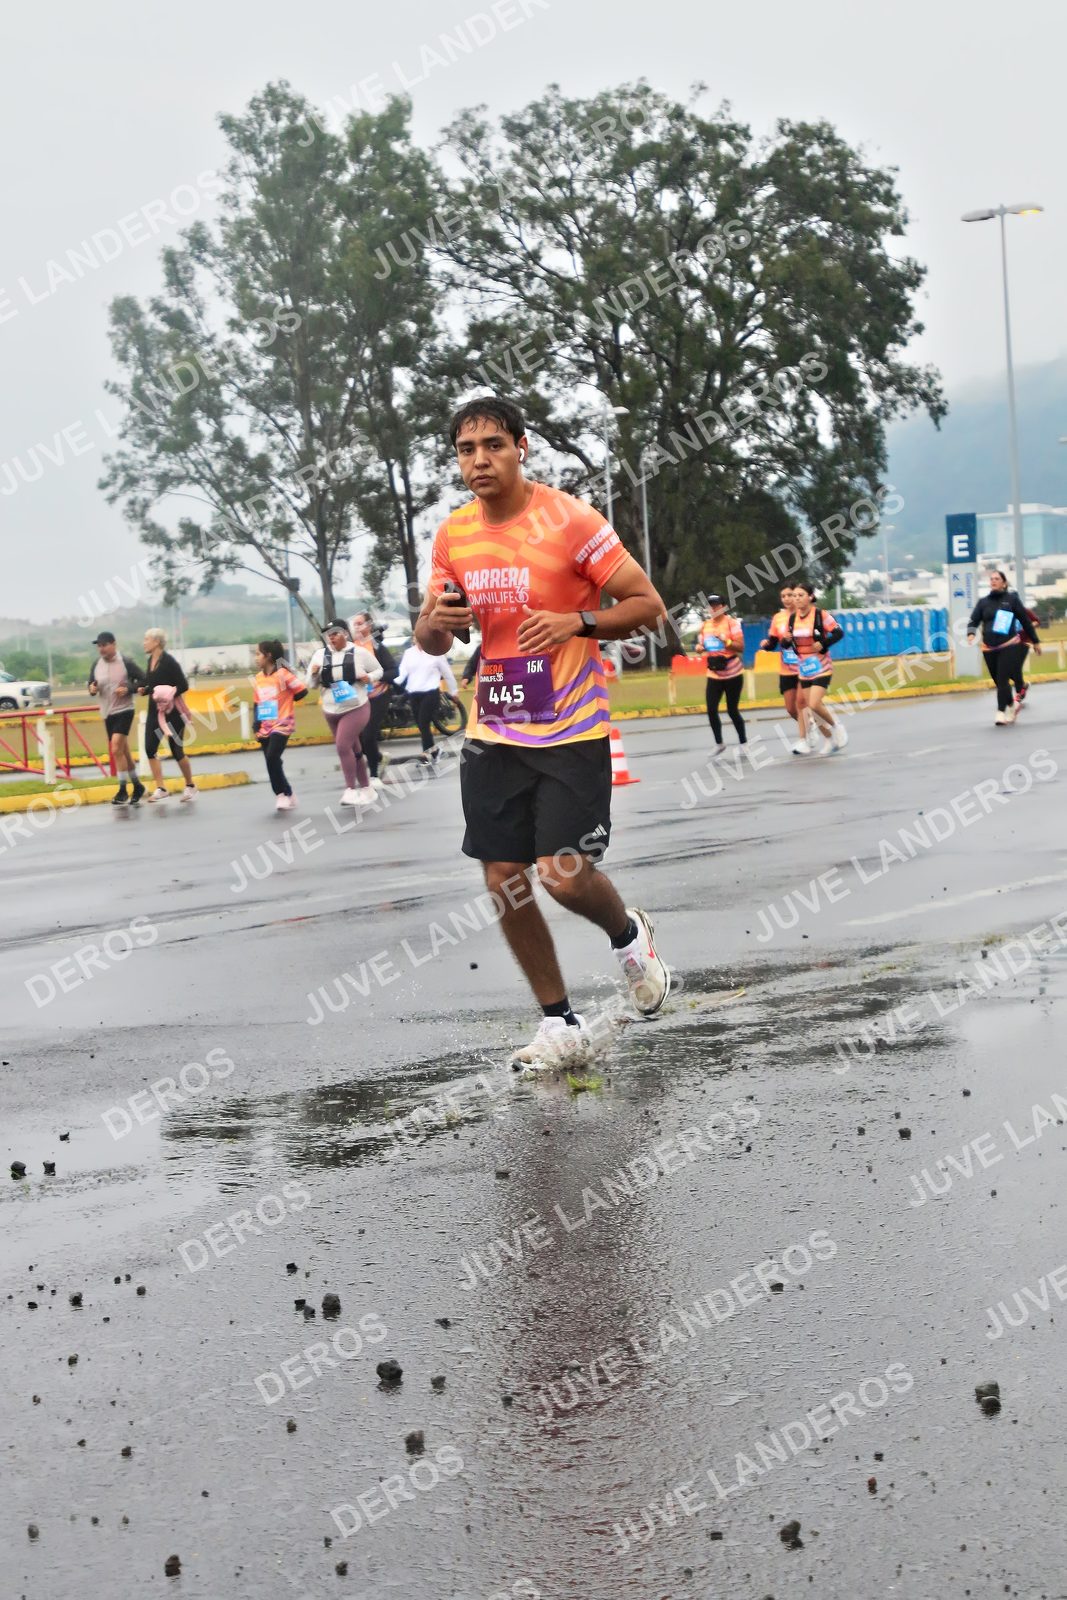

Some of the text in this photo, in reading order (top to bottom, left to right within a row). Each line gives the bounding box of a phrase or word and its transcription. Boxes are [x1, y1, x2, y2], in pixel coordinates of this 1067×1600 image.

[952, 534, 969, 558] E
[464, 567, 530, 591] CARRERA
[468, 590, 514, 606] OMNILIFE
[488, 684, 525, 704] 445
